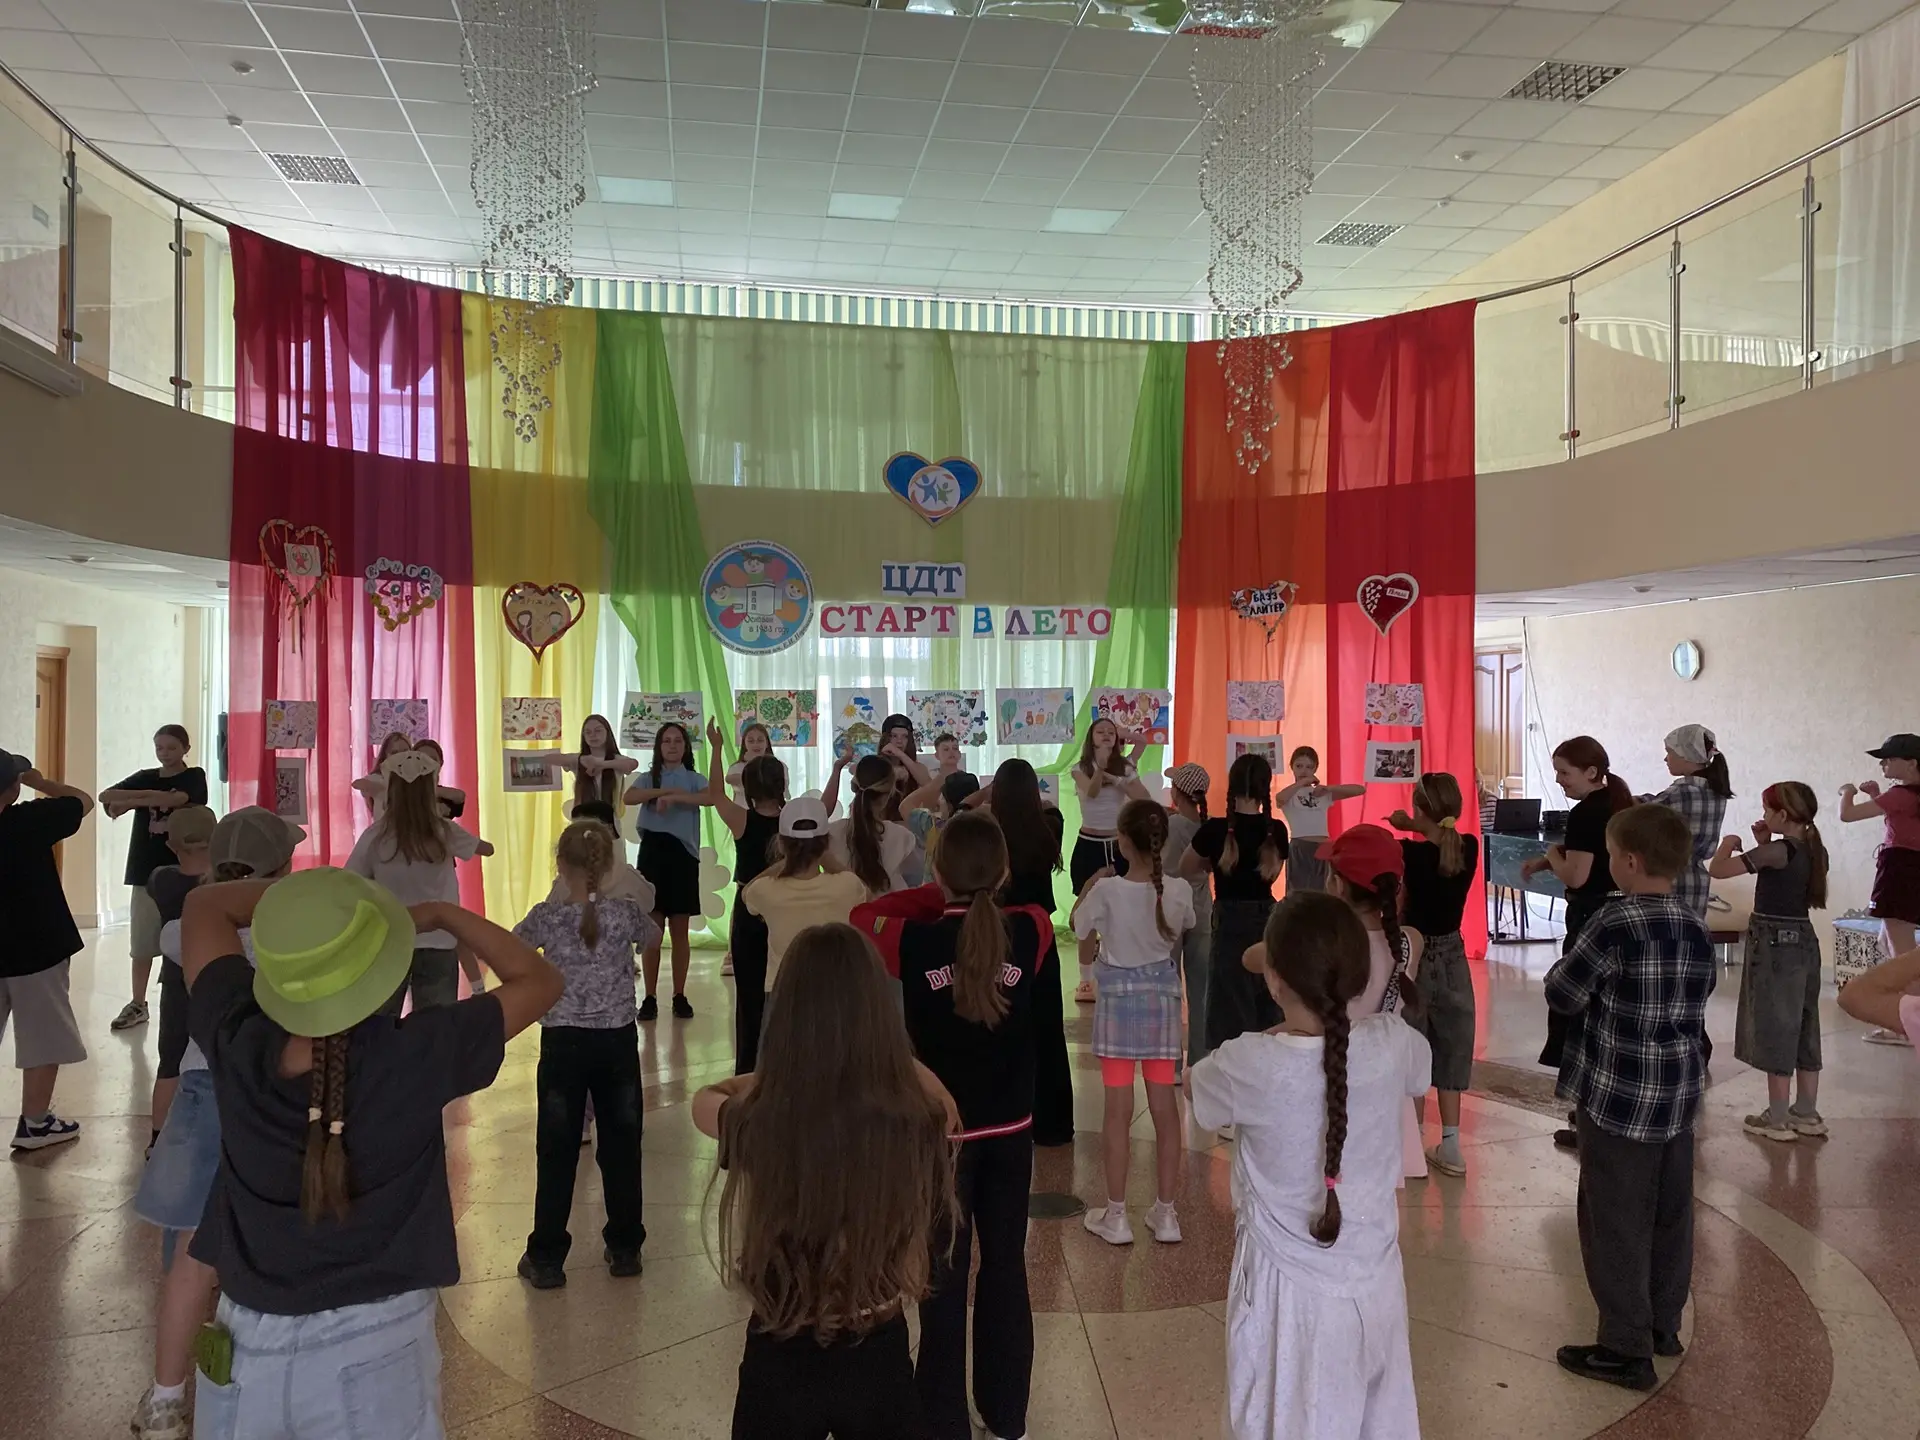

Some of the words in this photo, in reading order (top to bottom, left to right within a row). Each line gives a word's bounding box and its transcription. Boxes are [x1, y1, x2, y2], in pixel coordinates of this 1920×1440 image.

[882, 565, 962, 596] ЦДТ
[820, 605, 956, 633] СТАРТ
[974, 607, 993, 634] В
[1005, 608, 1111, 636] ЛЕТО
